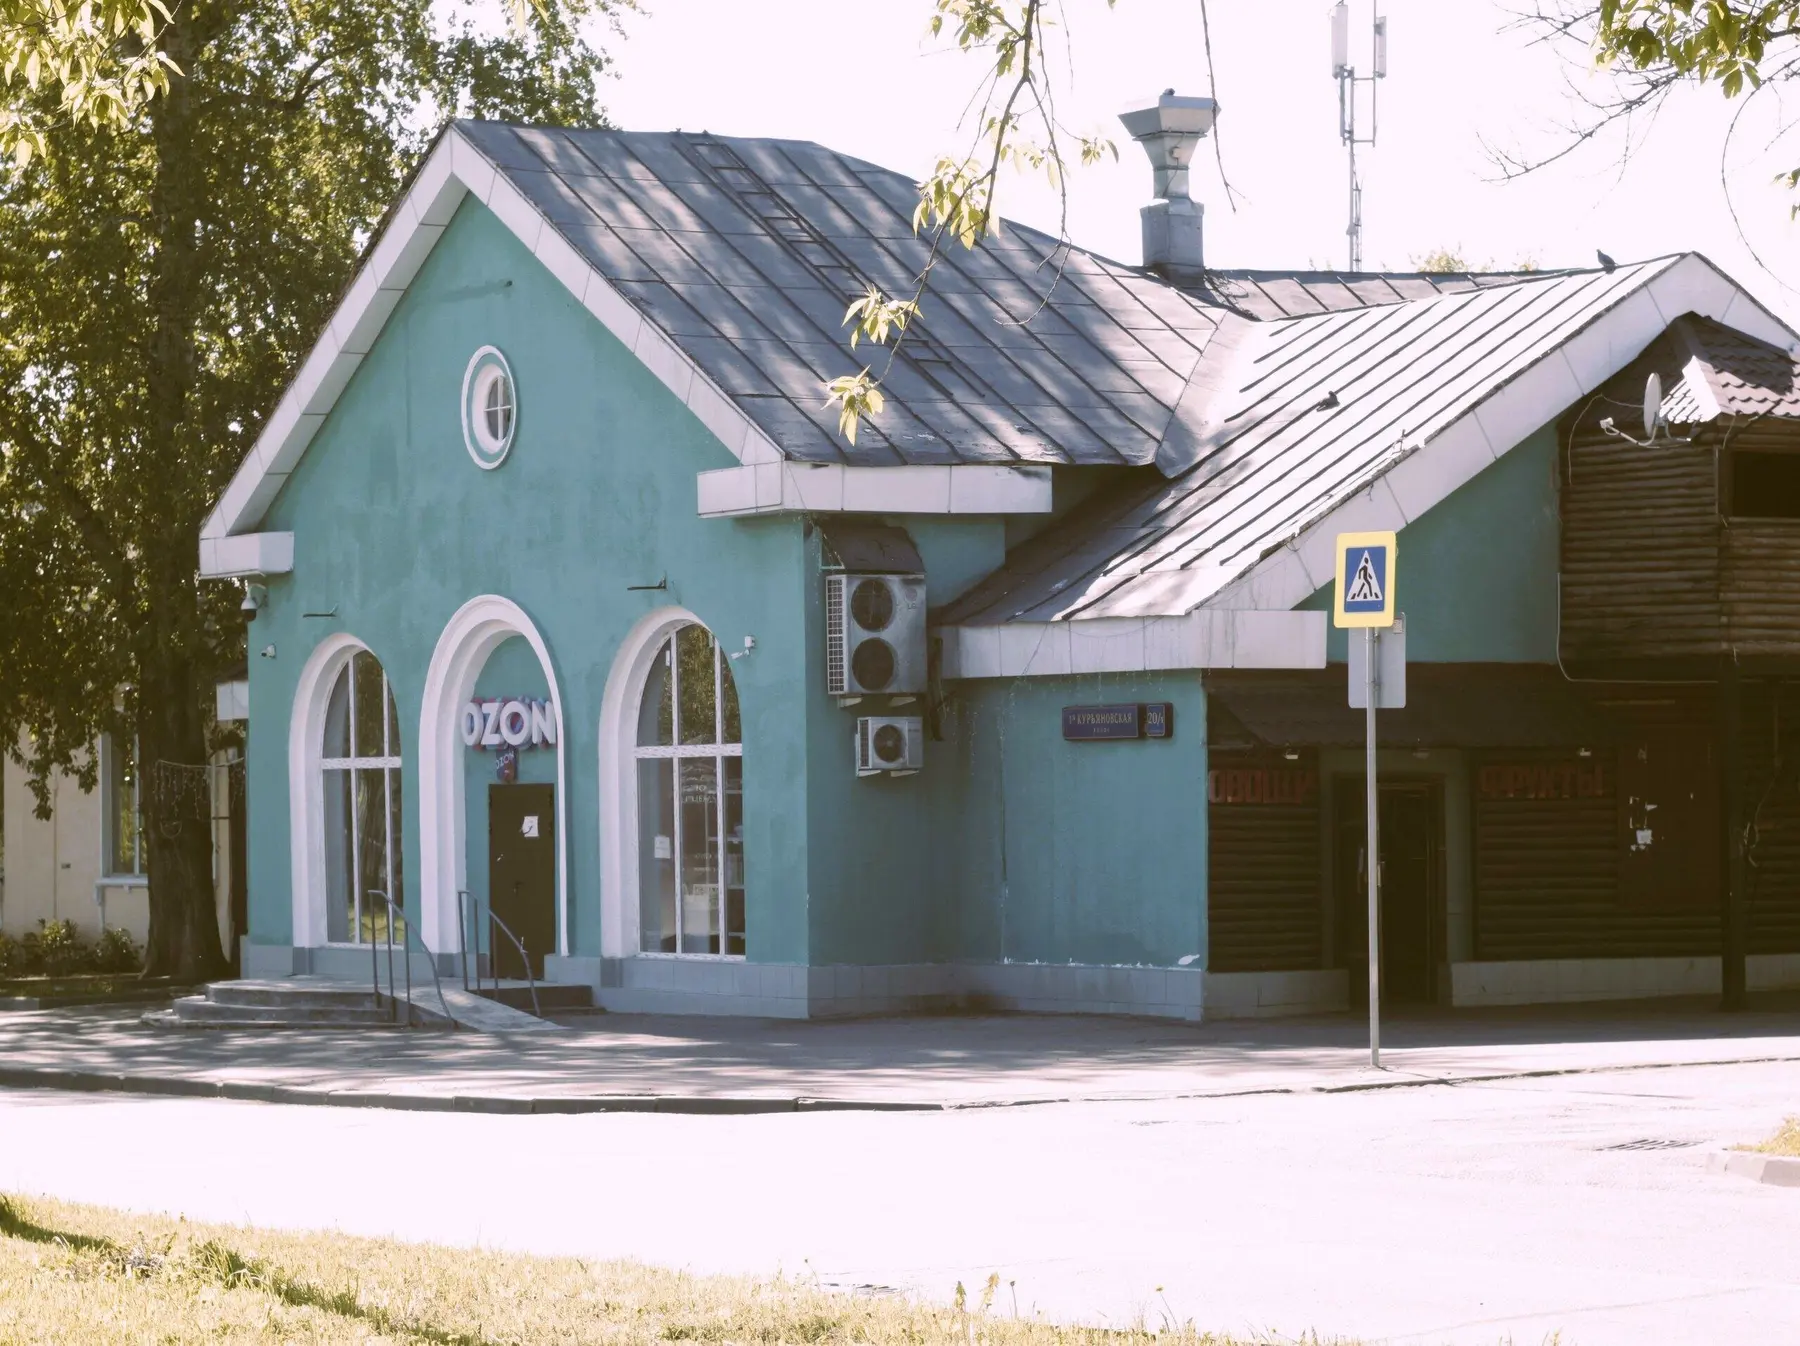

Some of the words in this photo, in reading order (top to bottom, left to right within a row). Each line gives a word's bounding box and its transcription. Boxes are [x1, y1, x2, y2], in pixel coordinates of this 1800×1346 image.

[461, 700, 556, 746] OZON
[1077, 712, 1132, 725] КУРЬЯНОВСКАЯ
[495, 750, 514, 769] OZON
[1208, 768, 1318, 804] ОВОЩИ
[1479, 764, 1605, 800] ФРУКТЫ
